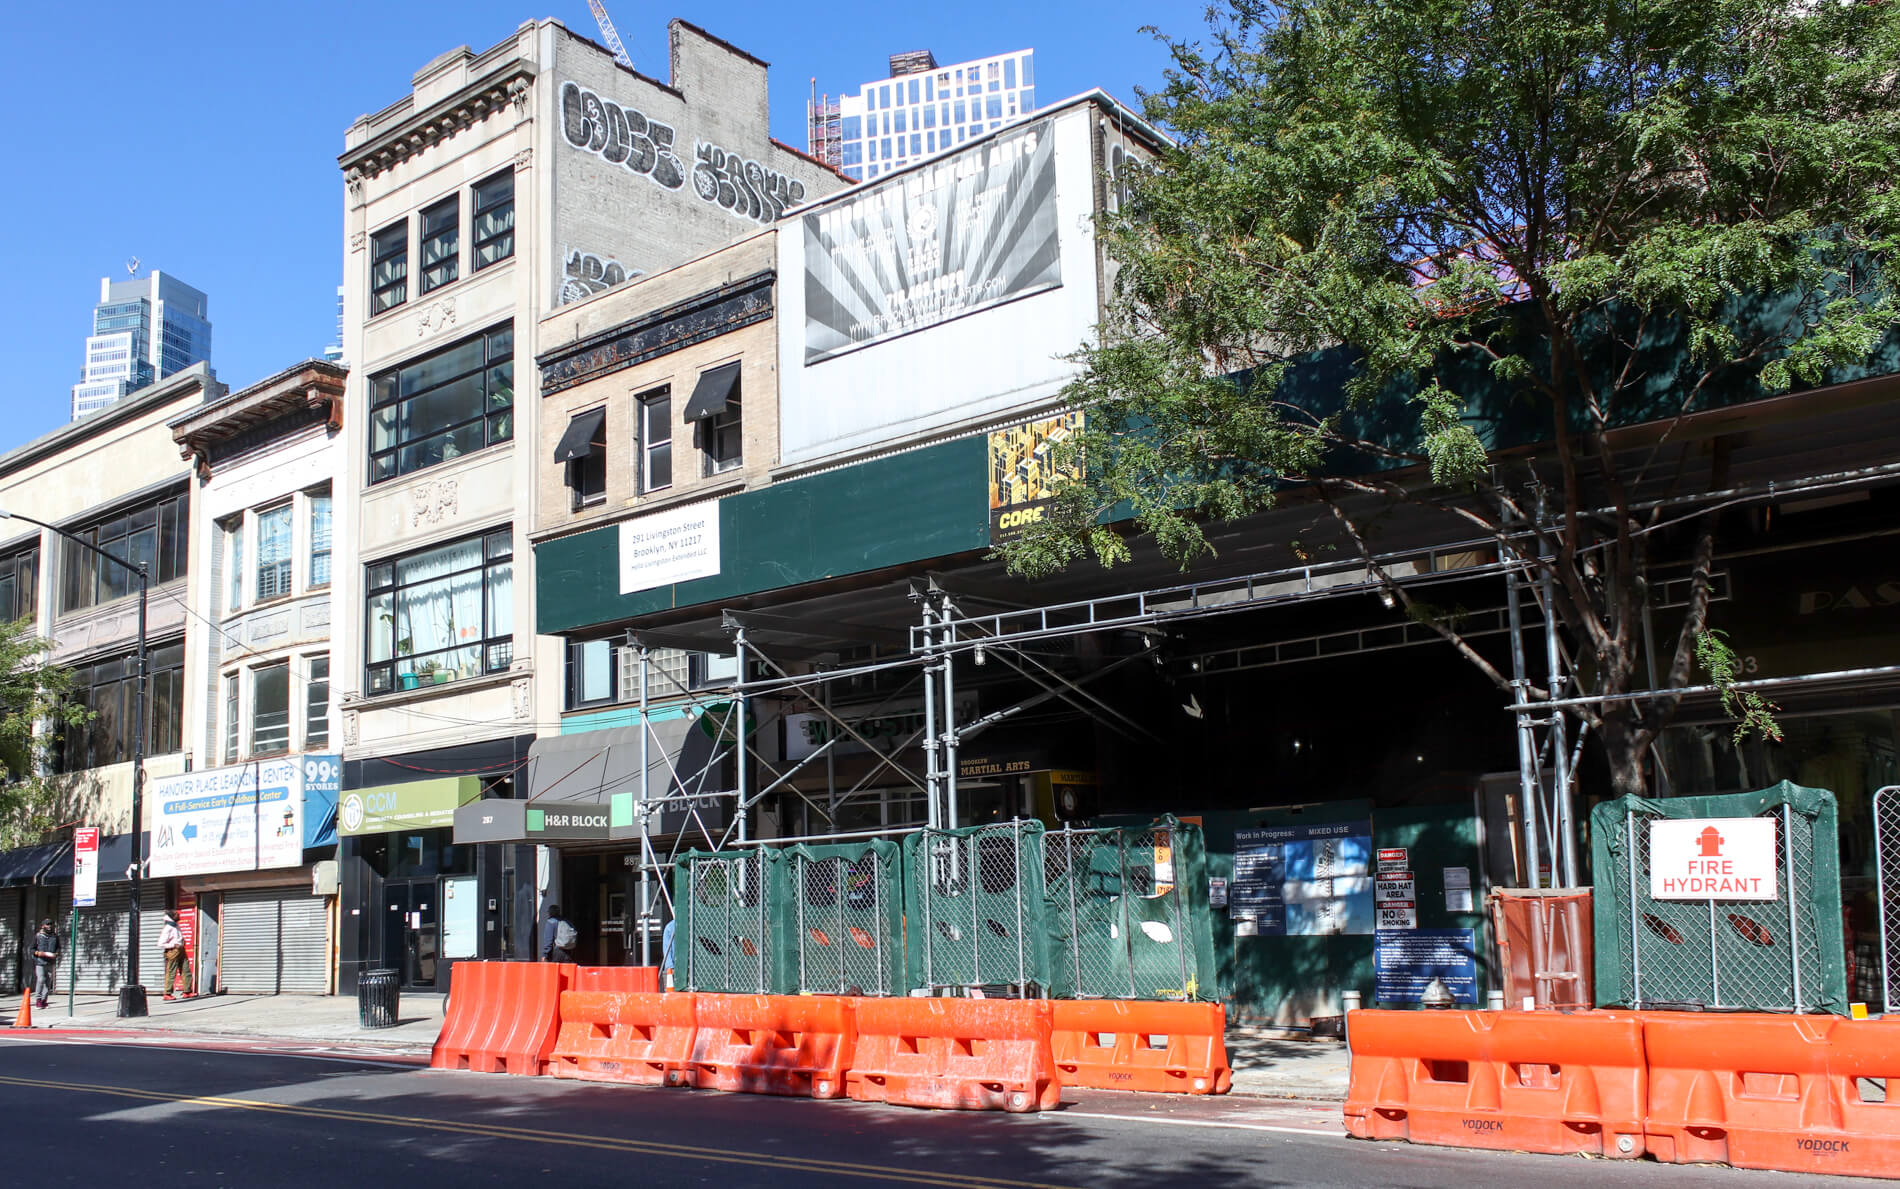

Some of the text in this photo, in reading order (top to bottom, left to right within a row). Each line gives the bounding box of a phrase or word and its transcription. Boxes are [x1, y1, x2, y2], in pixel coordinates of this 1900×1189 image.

[989, 131, 1038, 168] ARTS
[1000, 506, 1044, 529] CORE
[632, 520, 705, 544] 291 Livingston Street
[633, 535, 702, 558] Brooklyn, NY 11217
[305, 760, 339, 783] 99¢
[961, 761, 1030, 776] MARTIAL ARTS
[160, 765, 295, 798] HANOVER PLACE LEARNIN CENTER
[305, 782, 339, 791] STORES
[261, 791, 282, 800] Center
[366, 791, 397, 813] CCM
[545, 815, 607, 827] H&R BLOCK
[1261, 831, 1295, 841] Progress:
[1309, 827, 1332, 835] MIXED
[1688, 860, 1733, 875] FIRE
[1663, 878, 1761, 892] HYDRANT
[1382, 910, 1396, 919] NO
[1462, 1119, 1504, 1131] YODOCK
[1796, 1138, 1850, 1152] YODOCK
